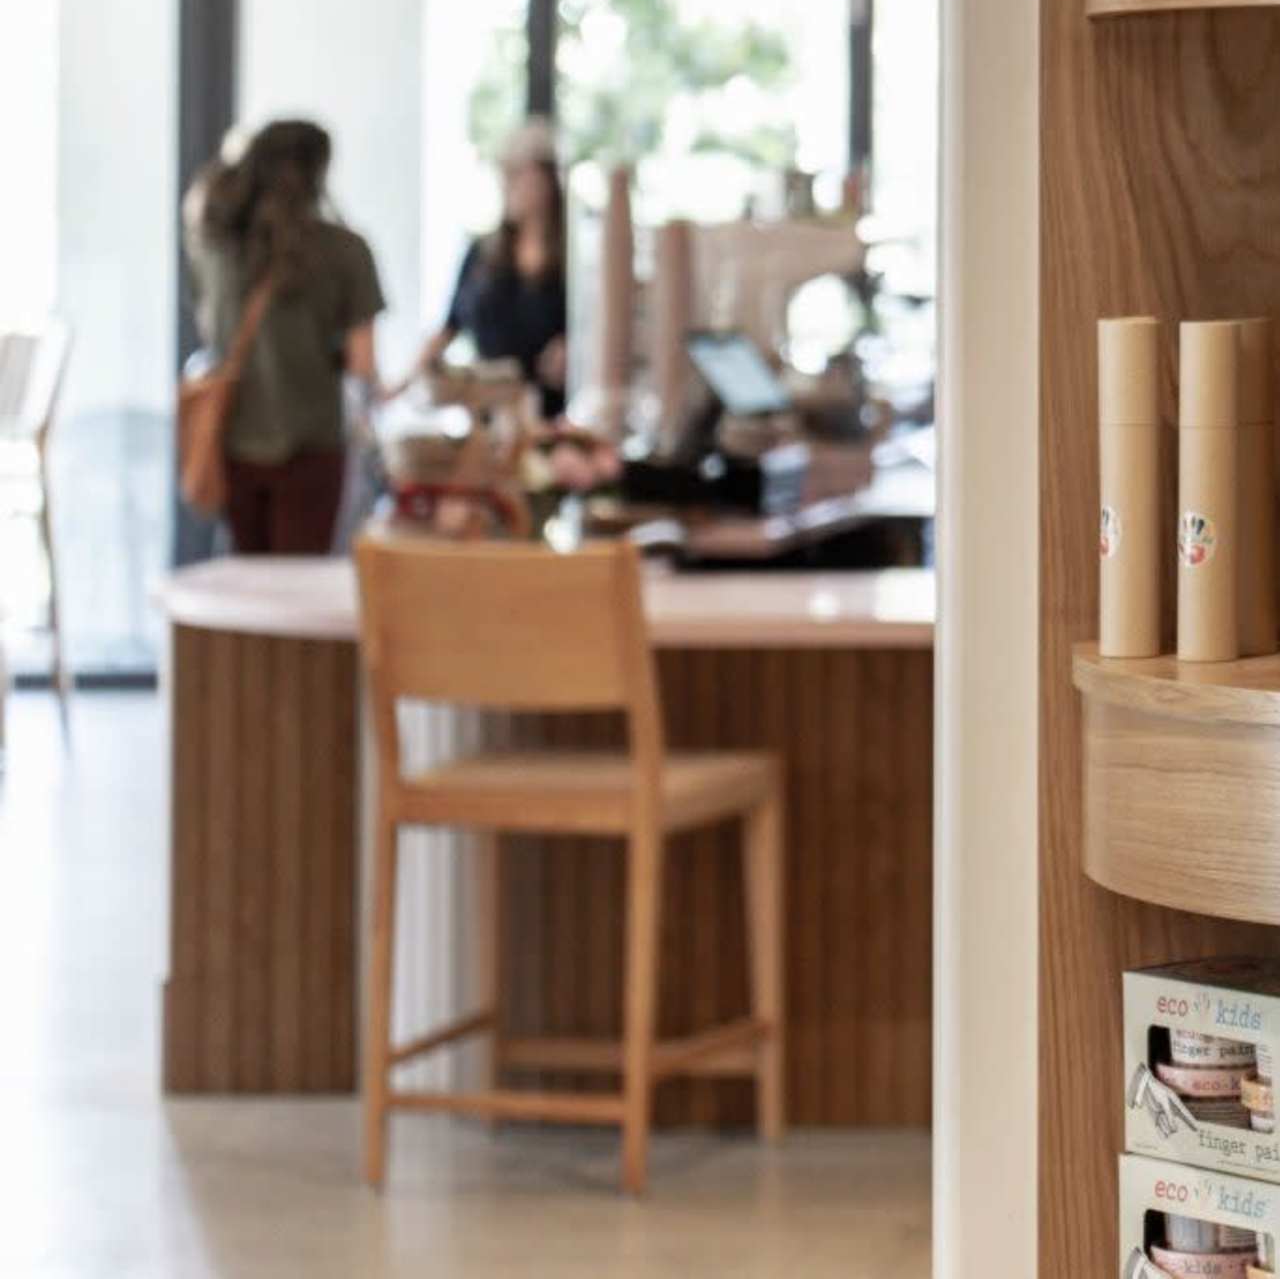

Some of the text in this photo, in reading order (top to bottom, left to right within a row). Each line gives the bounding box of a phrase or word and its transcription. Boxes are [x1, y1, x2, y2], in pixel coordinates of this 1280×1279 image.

[1157, 996, 1263, 1031] eco kids
[1200, 1129, 1247, 1157] finger
[1154, 1179, 1267, 1219] eco kids
